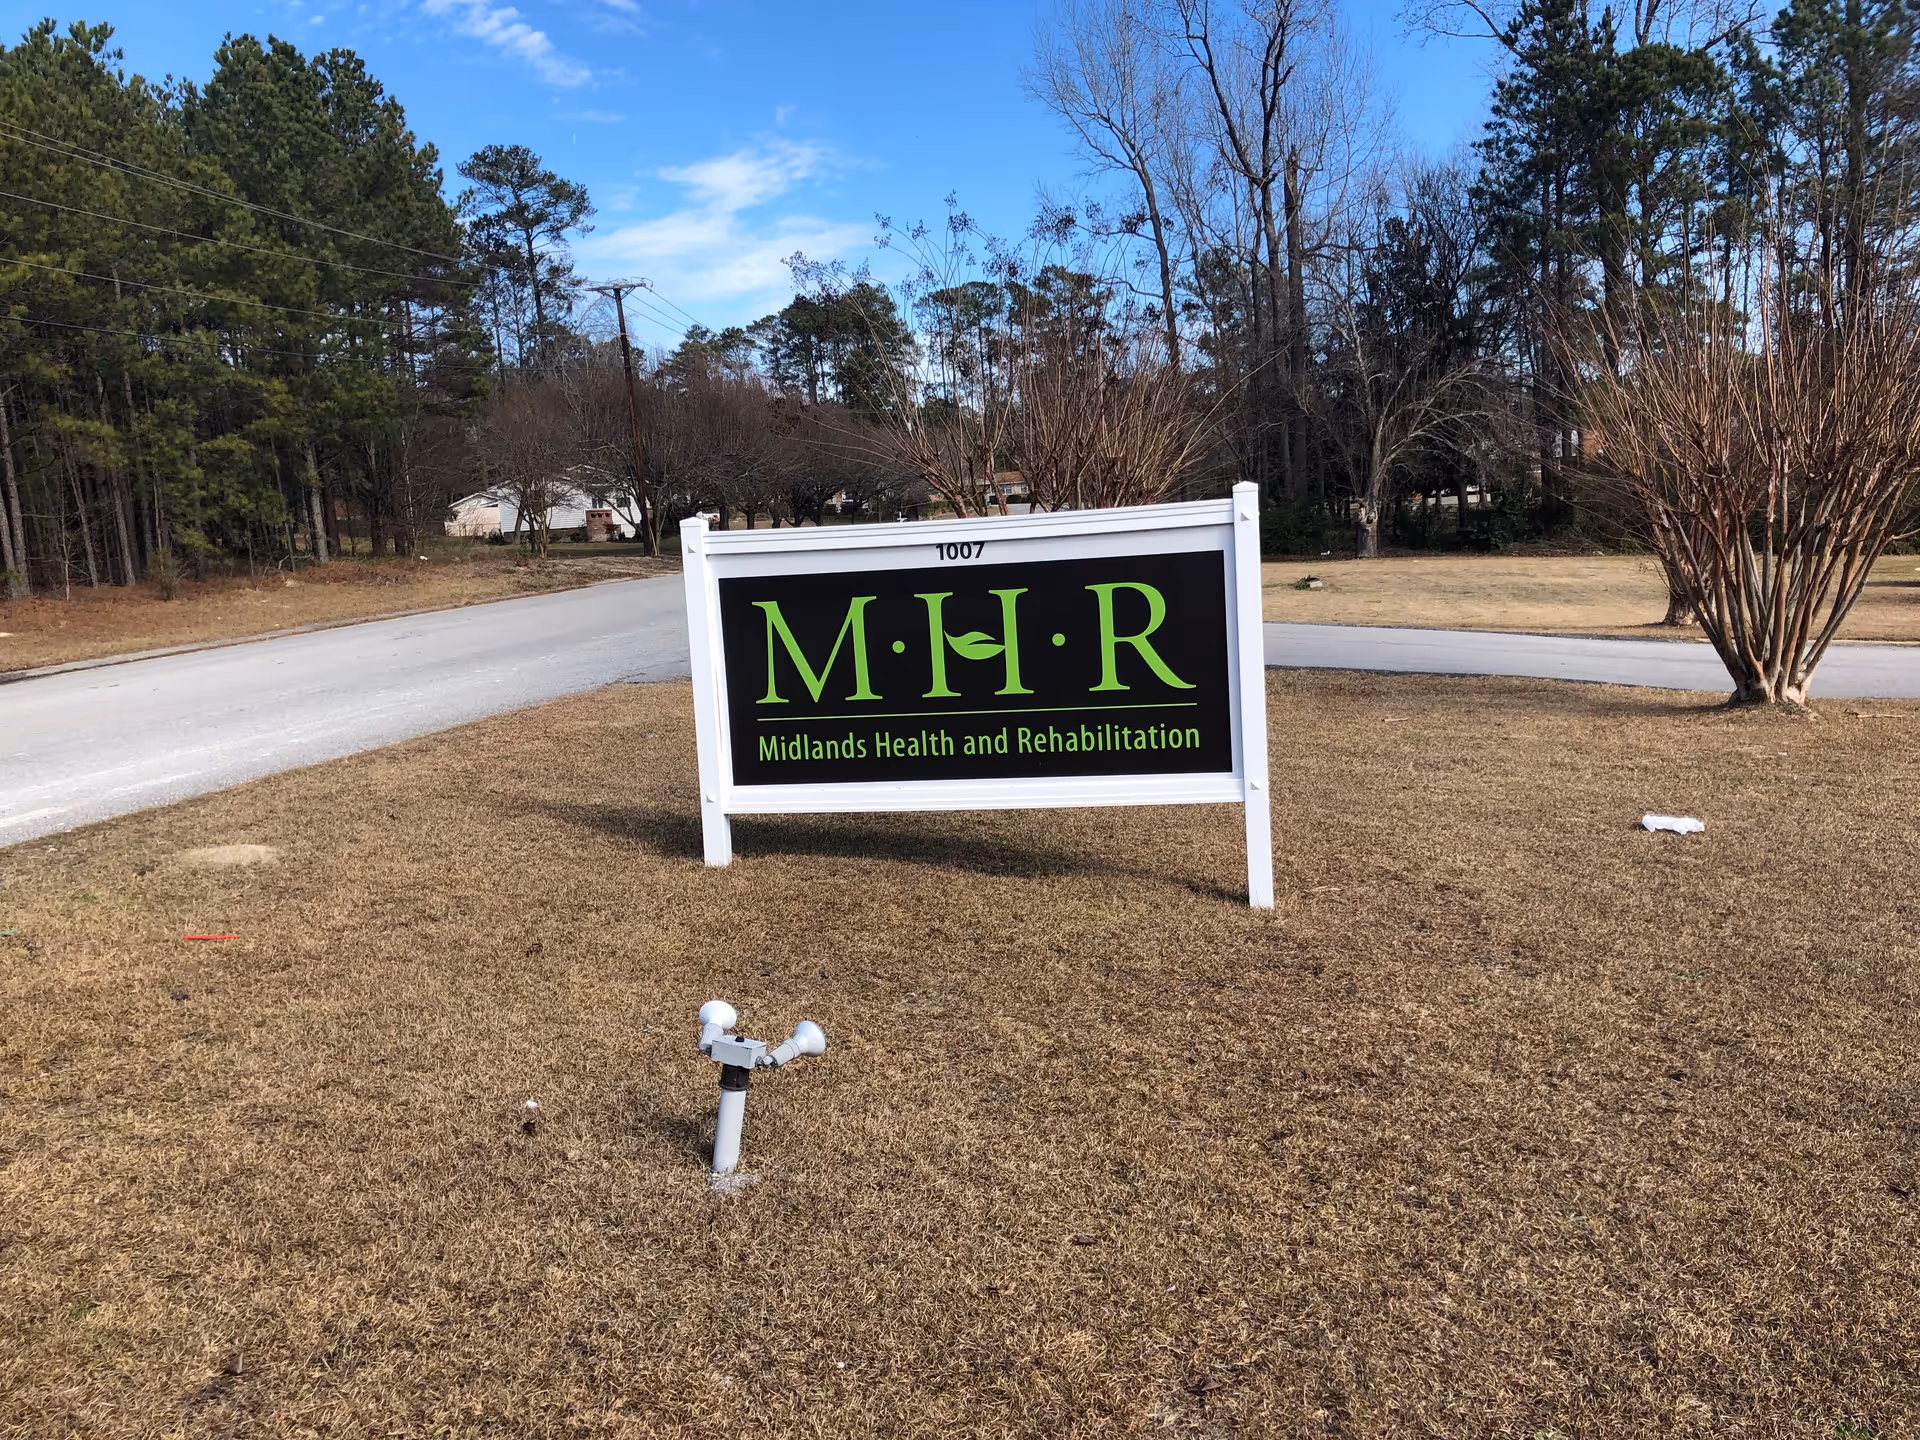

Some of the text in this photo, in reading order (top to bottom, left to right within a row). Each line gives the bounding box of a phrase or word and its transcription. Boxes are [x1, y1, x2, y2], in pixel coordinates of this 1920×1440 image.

[936, 541, 985, 561] 1007
[758, 722, 1201, 762] Midlands Health and Rehabilitation
